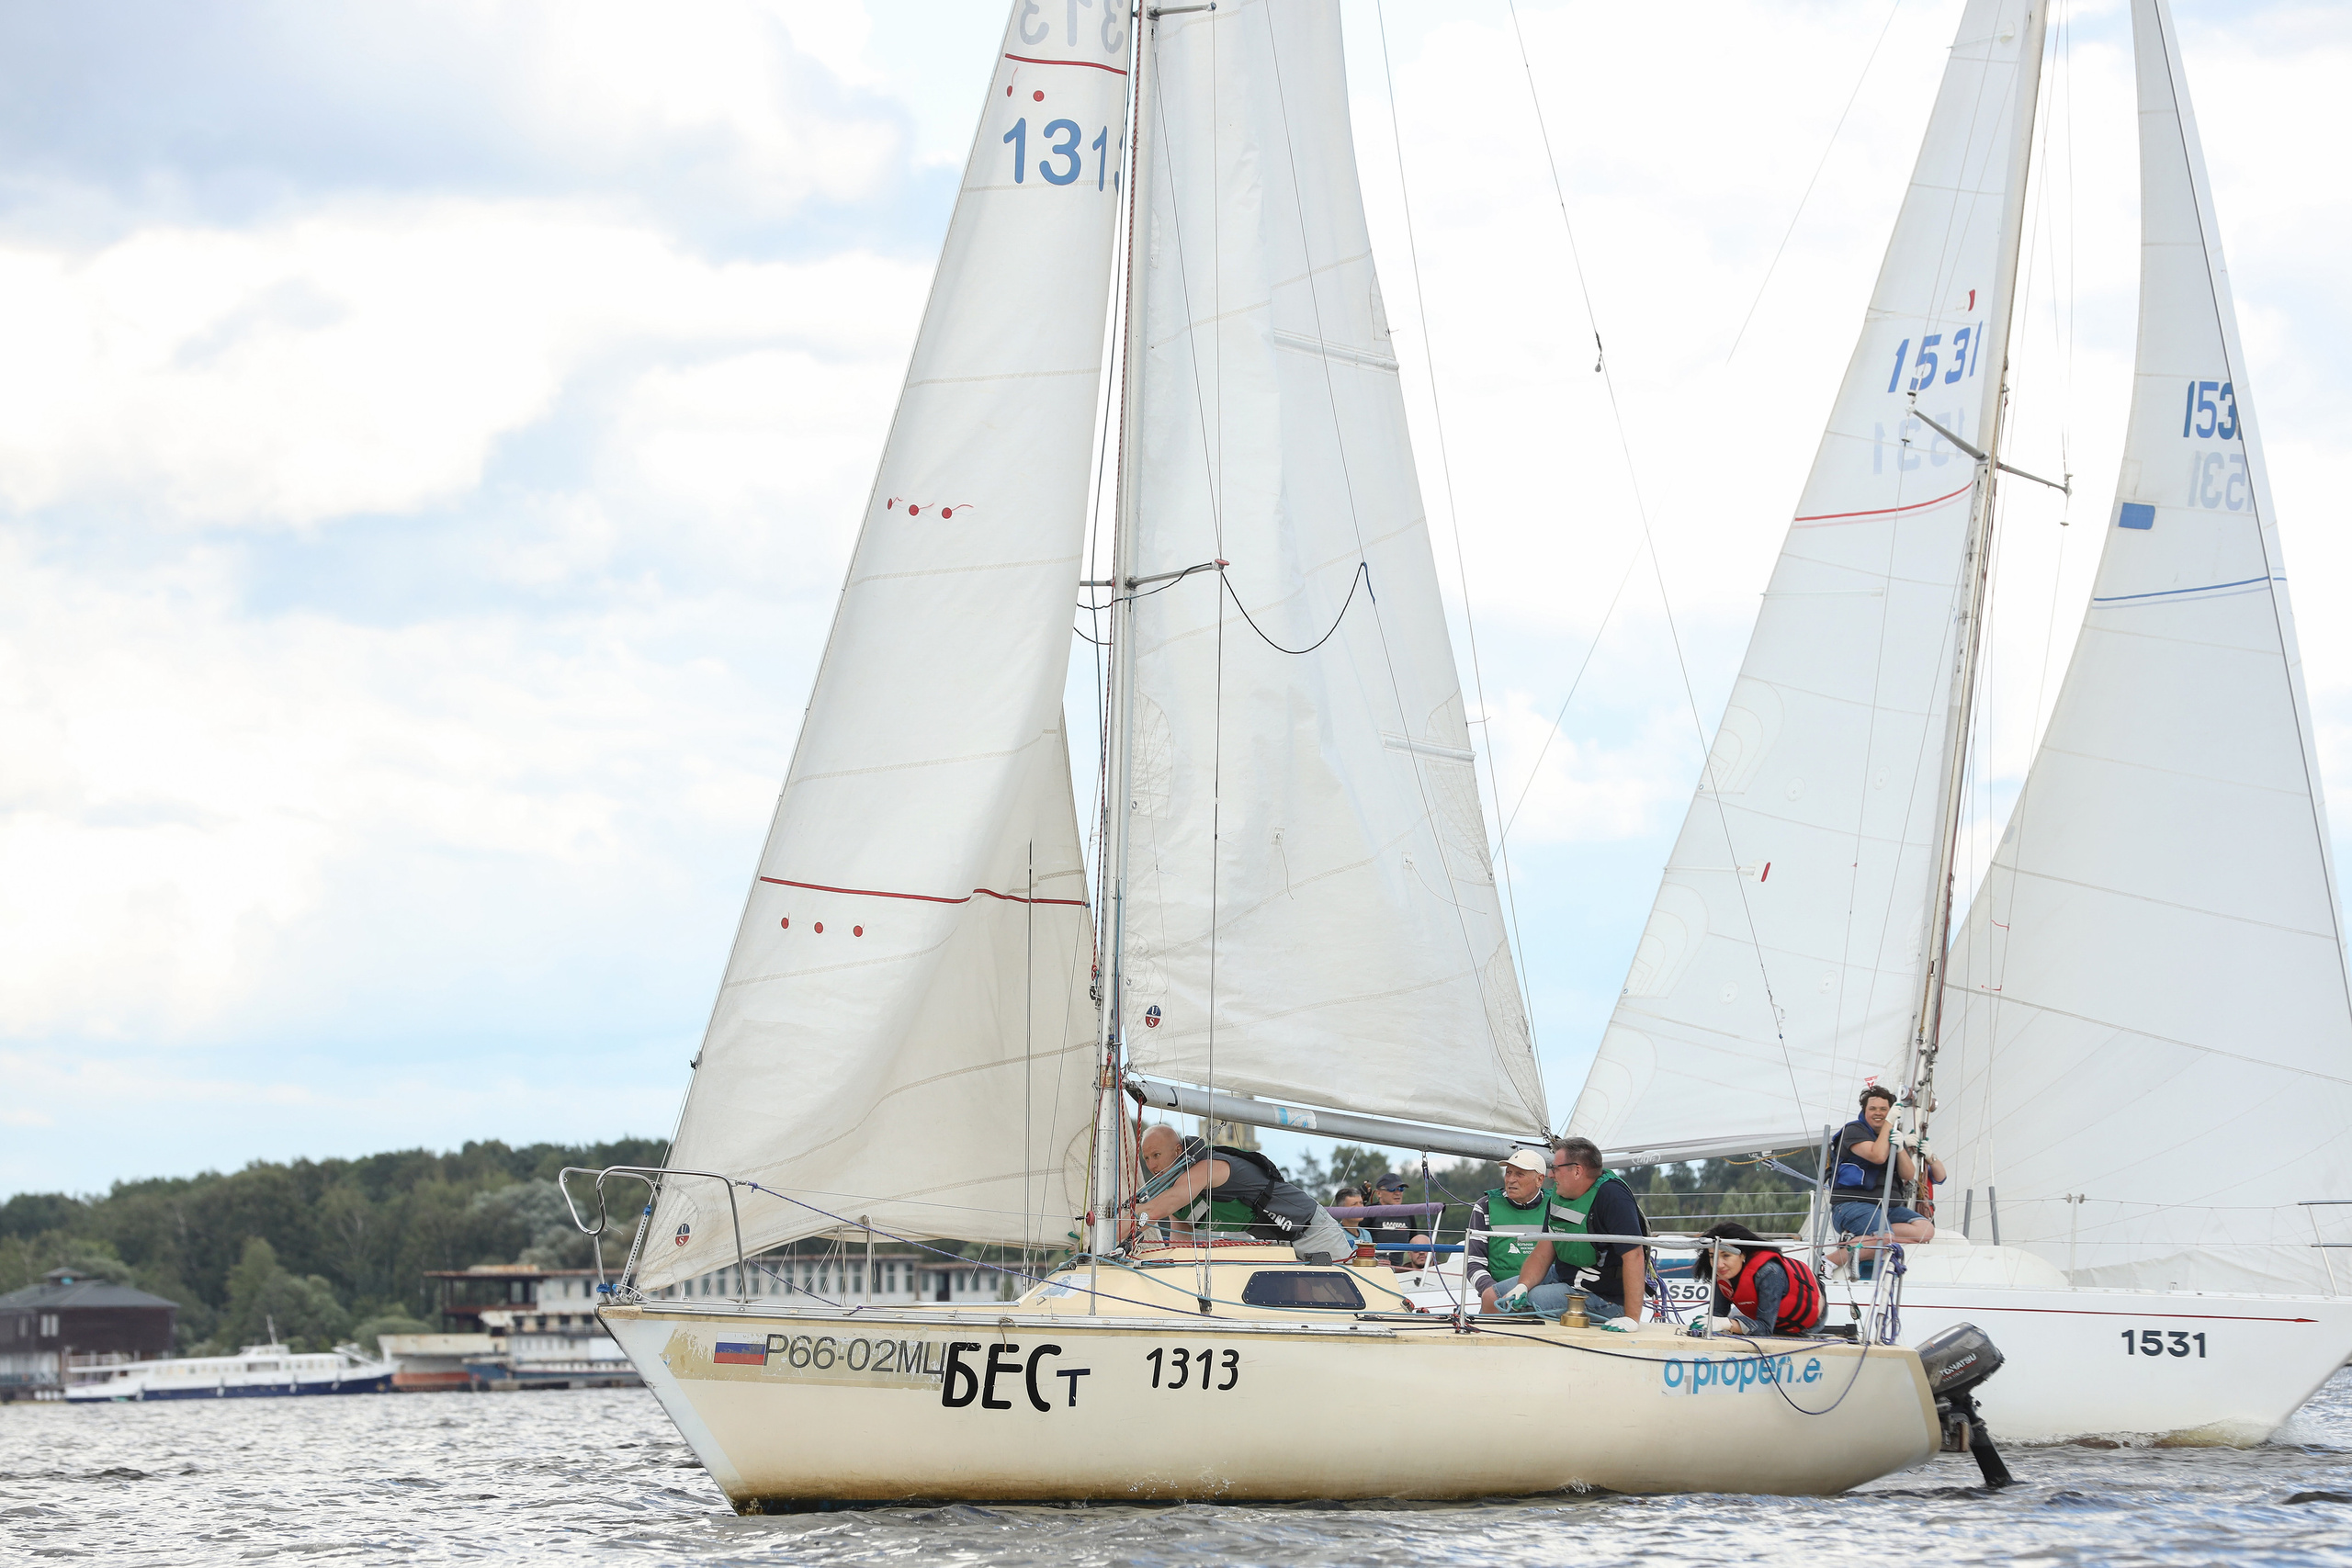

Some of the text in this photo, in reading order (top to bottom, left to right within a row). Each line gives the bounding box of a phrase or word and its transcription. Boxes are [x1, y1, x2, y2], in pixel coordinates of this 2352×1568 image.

[1002, 117, 1125, 197] 131
[1887, 320, 1983, 393] 1531
[2183, 380, 2243, 441] 153
[1146, 1347, 1240, 1391] 1313
[1939, 1352, 1977, 1376] TOHATSU
[2121, 1328, 2206, 1359] 1531
